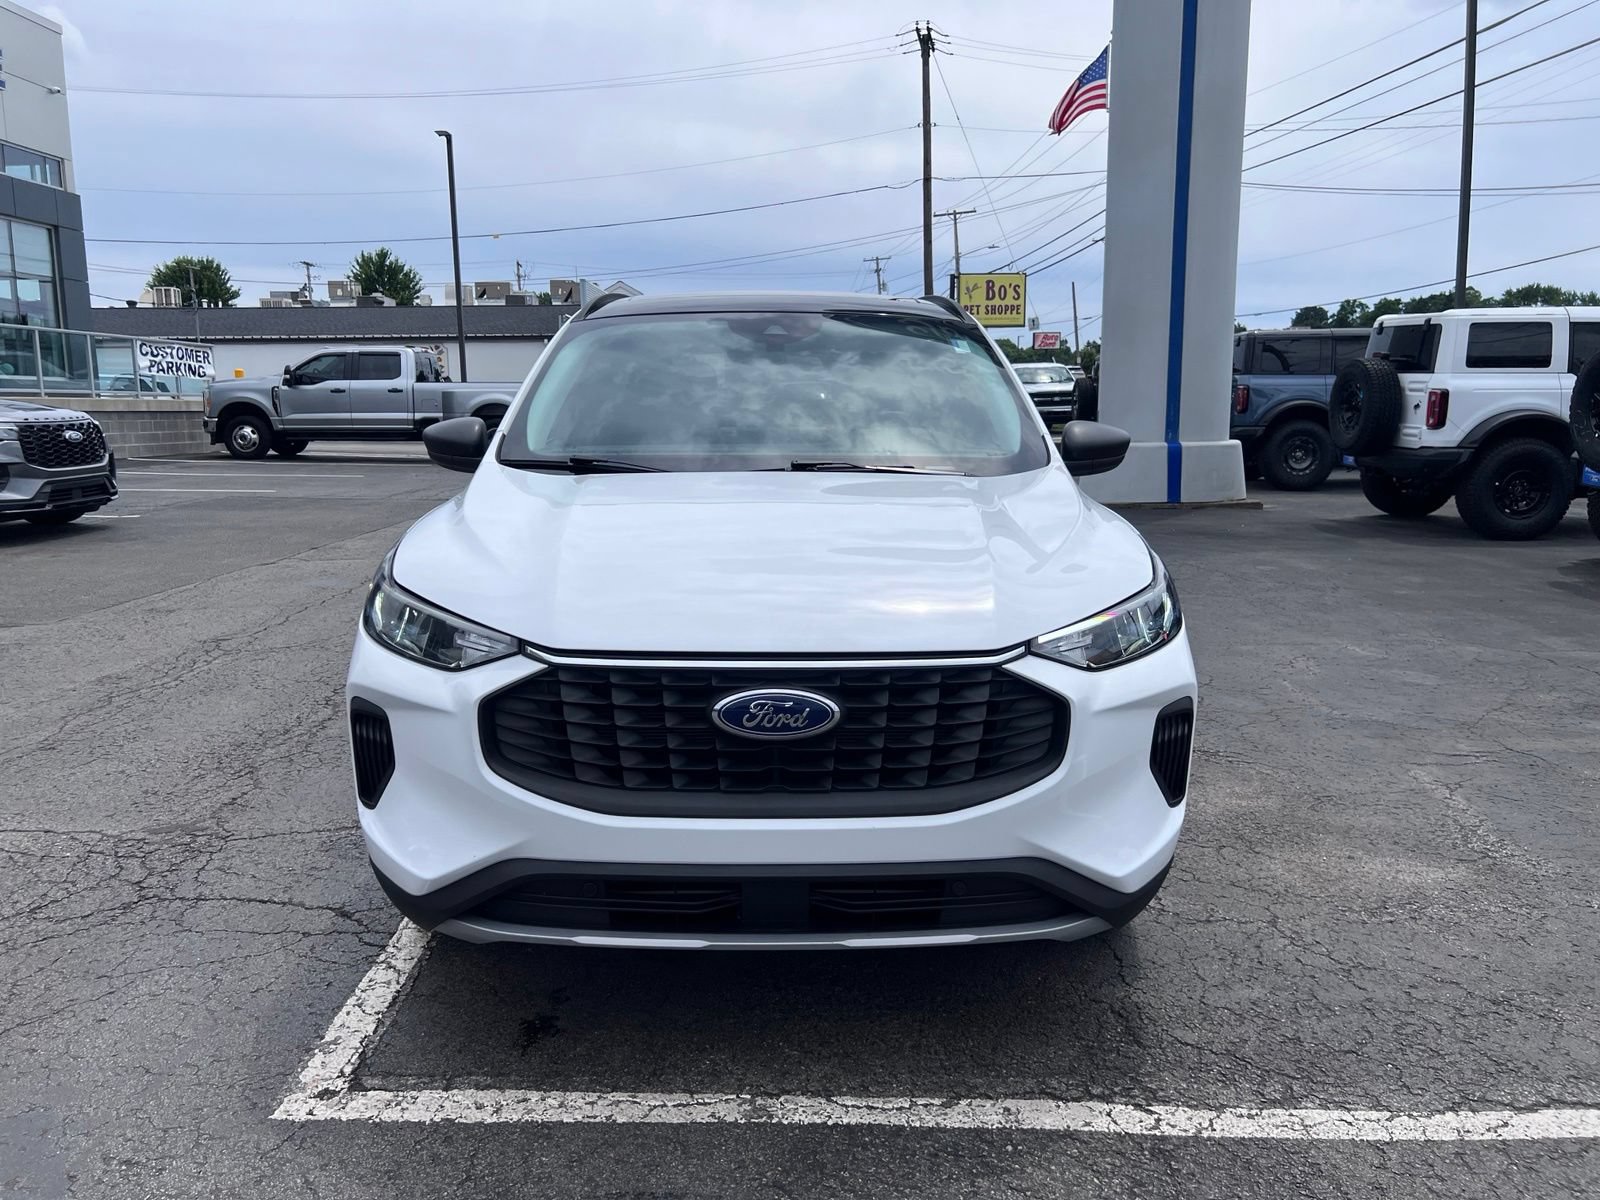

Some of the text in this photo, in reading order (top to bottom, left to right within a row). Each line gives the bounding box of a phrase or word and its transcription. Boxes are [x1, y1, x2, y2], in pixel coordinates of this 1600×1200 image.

[984, 304, 1022, 315] SHOPPE
[139, 342, 212, 365] CUSTOMER
[148, 359, 207, 378] PARKING
[742, 700, 810, 728] Ford
